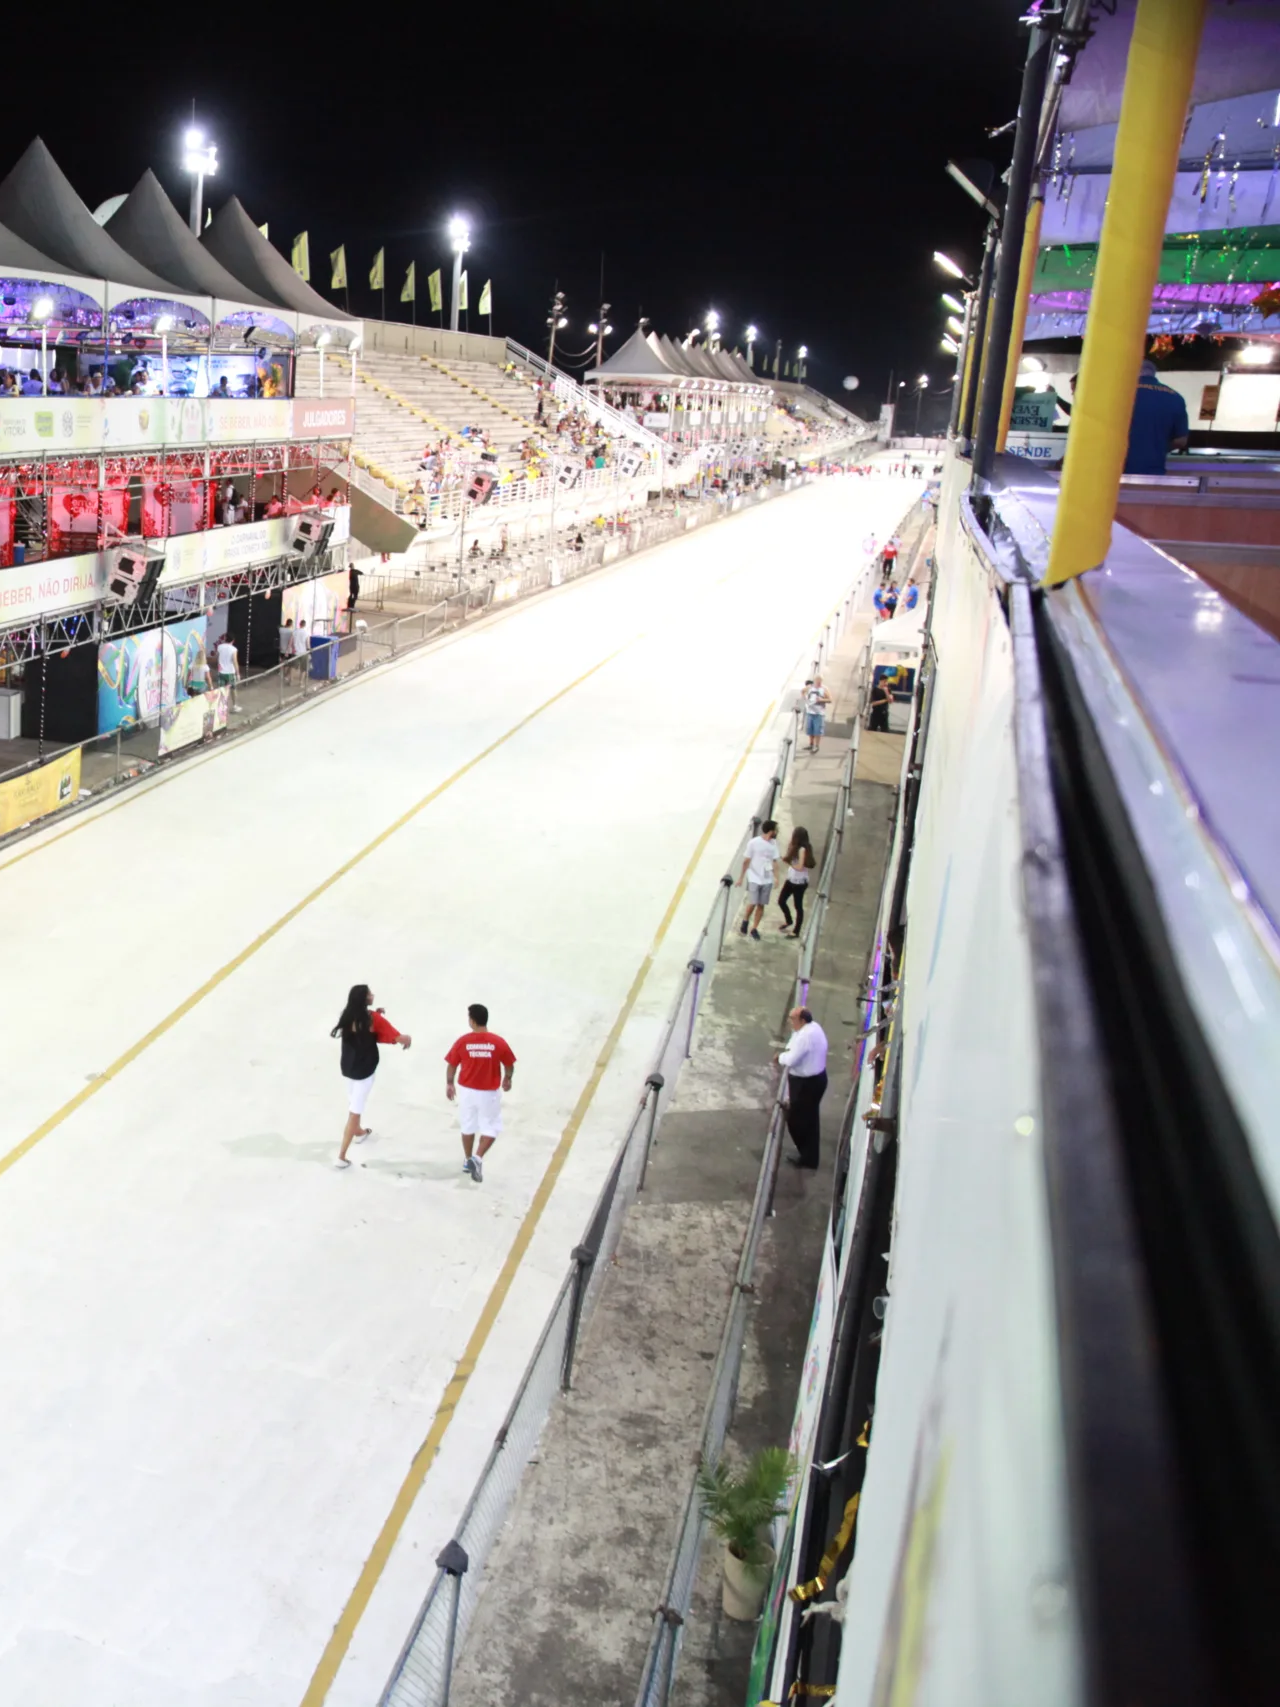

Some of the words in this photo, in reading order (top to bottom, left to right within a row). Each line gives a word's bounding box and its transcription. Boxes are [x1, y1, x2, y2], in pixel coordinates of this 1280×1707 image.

[1005, 445, 1052, 458] SENDE
[38, 578, 60, 599] NÃO
[466, 1042, 496, 1051] COMISSÃO
